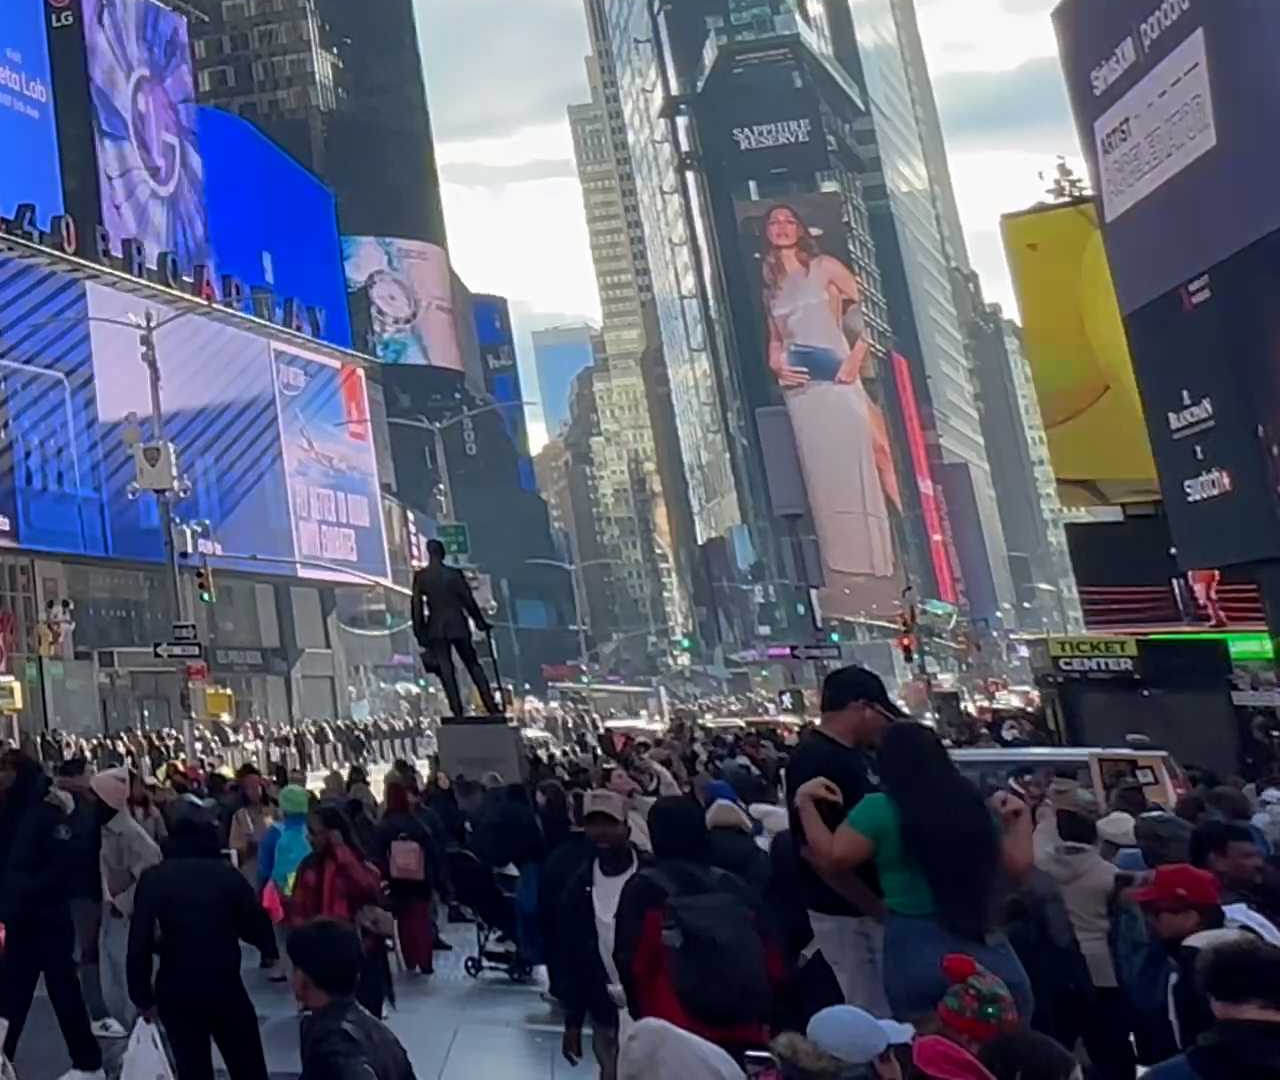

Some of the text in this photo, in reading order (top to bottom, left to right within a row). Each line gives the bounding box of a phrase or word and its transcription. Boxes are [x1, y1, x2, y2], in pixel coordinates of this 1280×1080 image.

[51, 11, 74, 28] LG
[21, 71, 46, 103] Lab
[732, 119, 811, 141] SAPPHIRE
[740, 130, 809, 150] RESERVE
[1057, 640, 1128, 654] TICKET
[1058, 657, 1134, 671] CENTER
